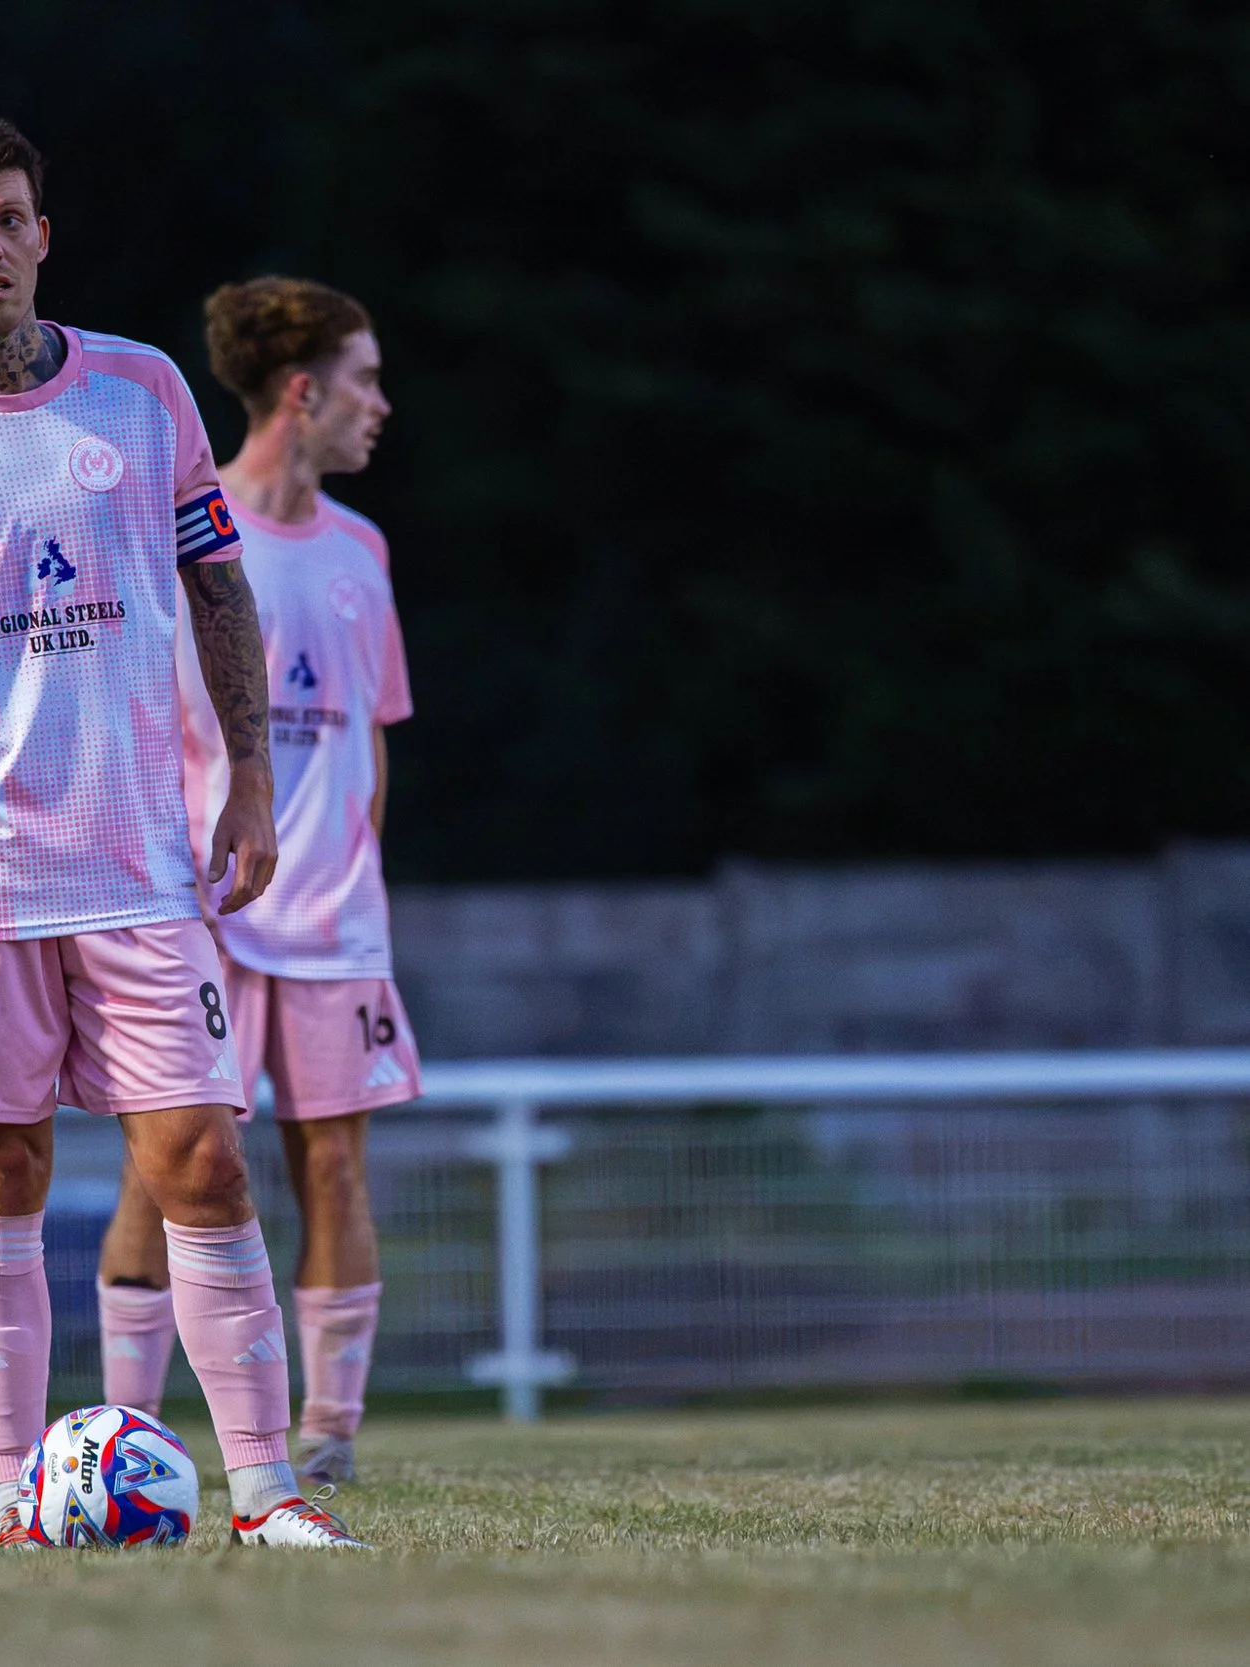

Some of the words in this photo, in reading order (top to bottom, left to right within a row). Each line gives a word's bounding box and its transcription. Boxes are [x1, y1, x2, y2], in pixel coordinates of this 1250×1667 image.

[208, 498, 234, 536] C
[66, 600, 126, 624] STEELS
[30, 634, 55, 654] UK
[58, 629, 95, 650] LTD.
[199, 981, 227, 1040] 8
[356, 1004, 397, 1053] 16
[81, 1436, 100, 1495] Mitre
